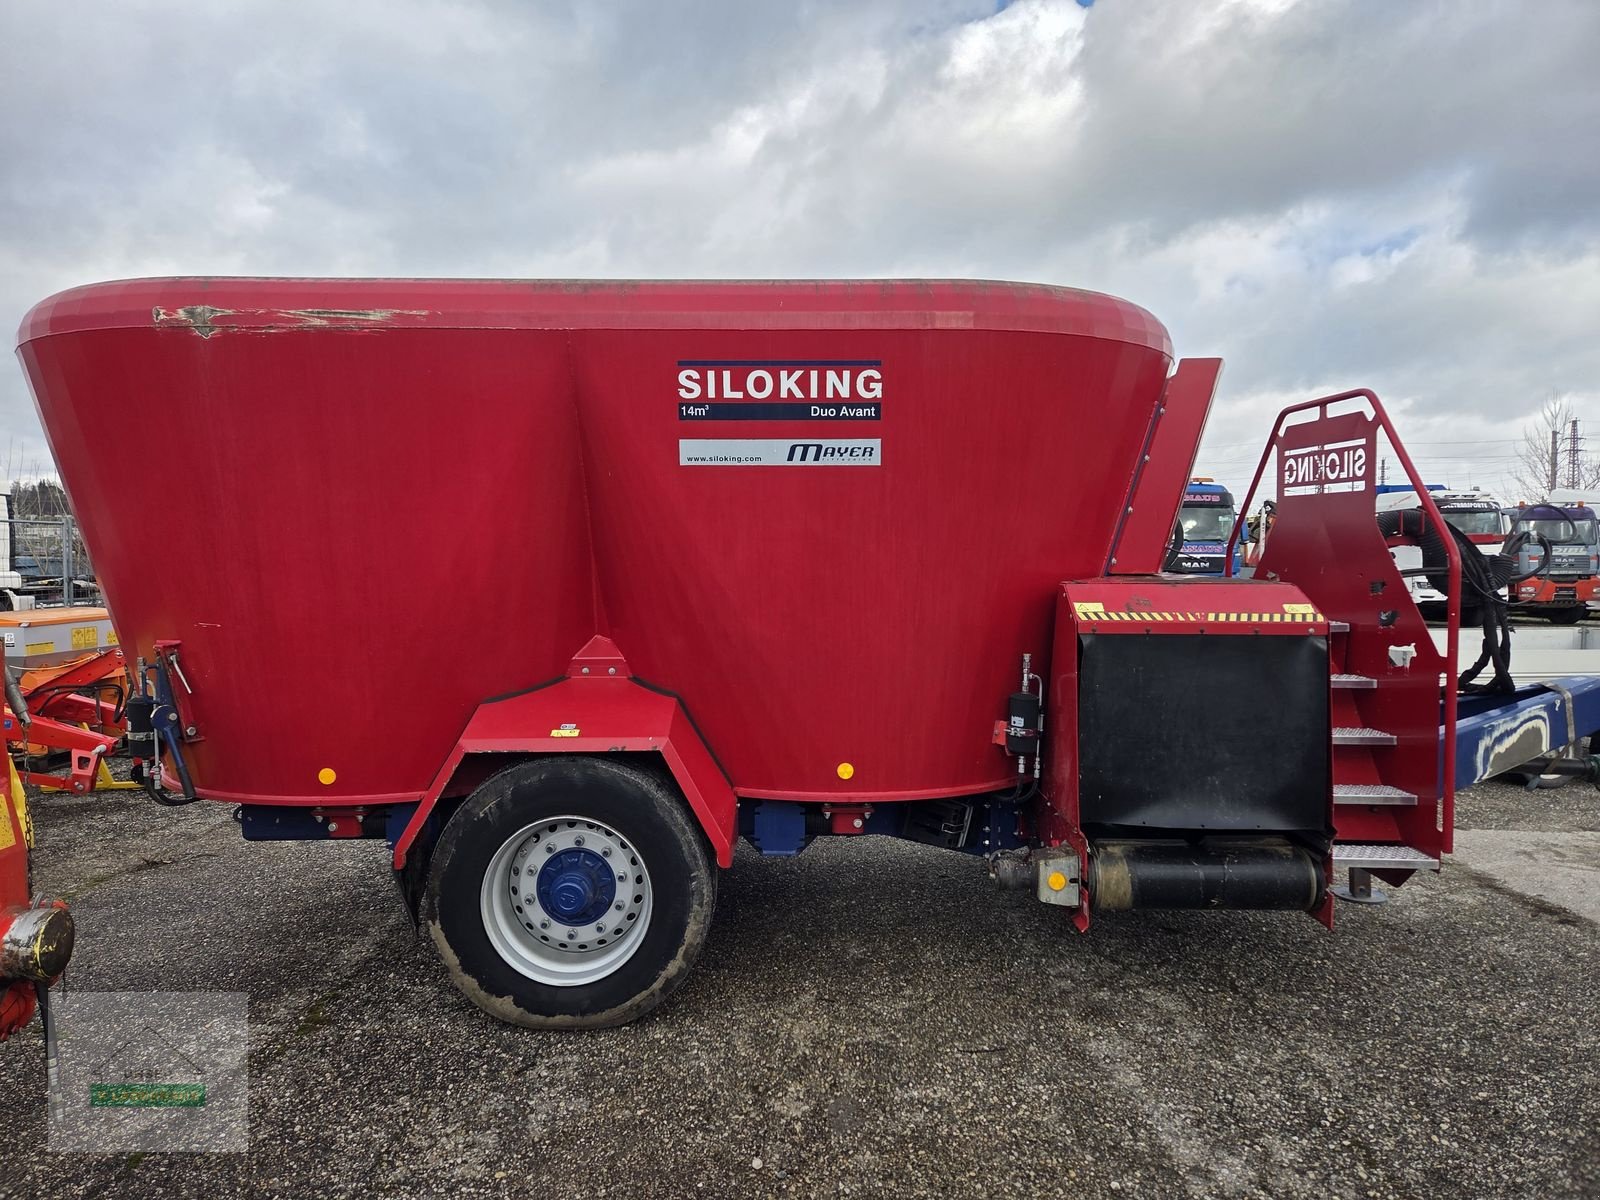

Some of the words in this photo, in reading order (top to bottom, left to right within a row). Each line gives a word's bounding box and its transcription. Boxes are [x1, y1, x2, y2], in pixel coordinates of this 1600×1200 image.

[677, 369, 883, 399] SILOKING
[810, 406, 836, 417] Duo
[839, 406, 876, 417] Avant
[686, 455, 762, 464] www.siloking.com
